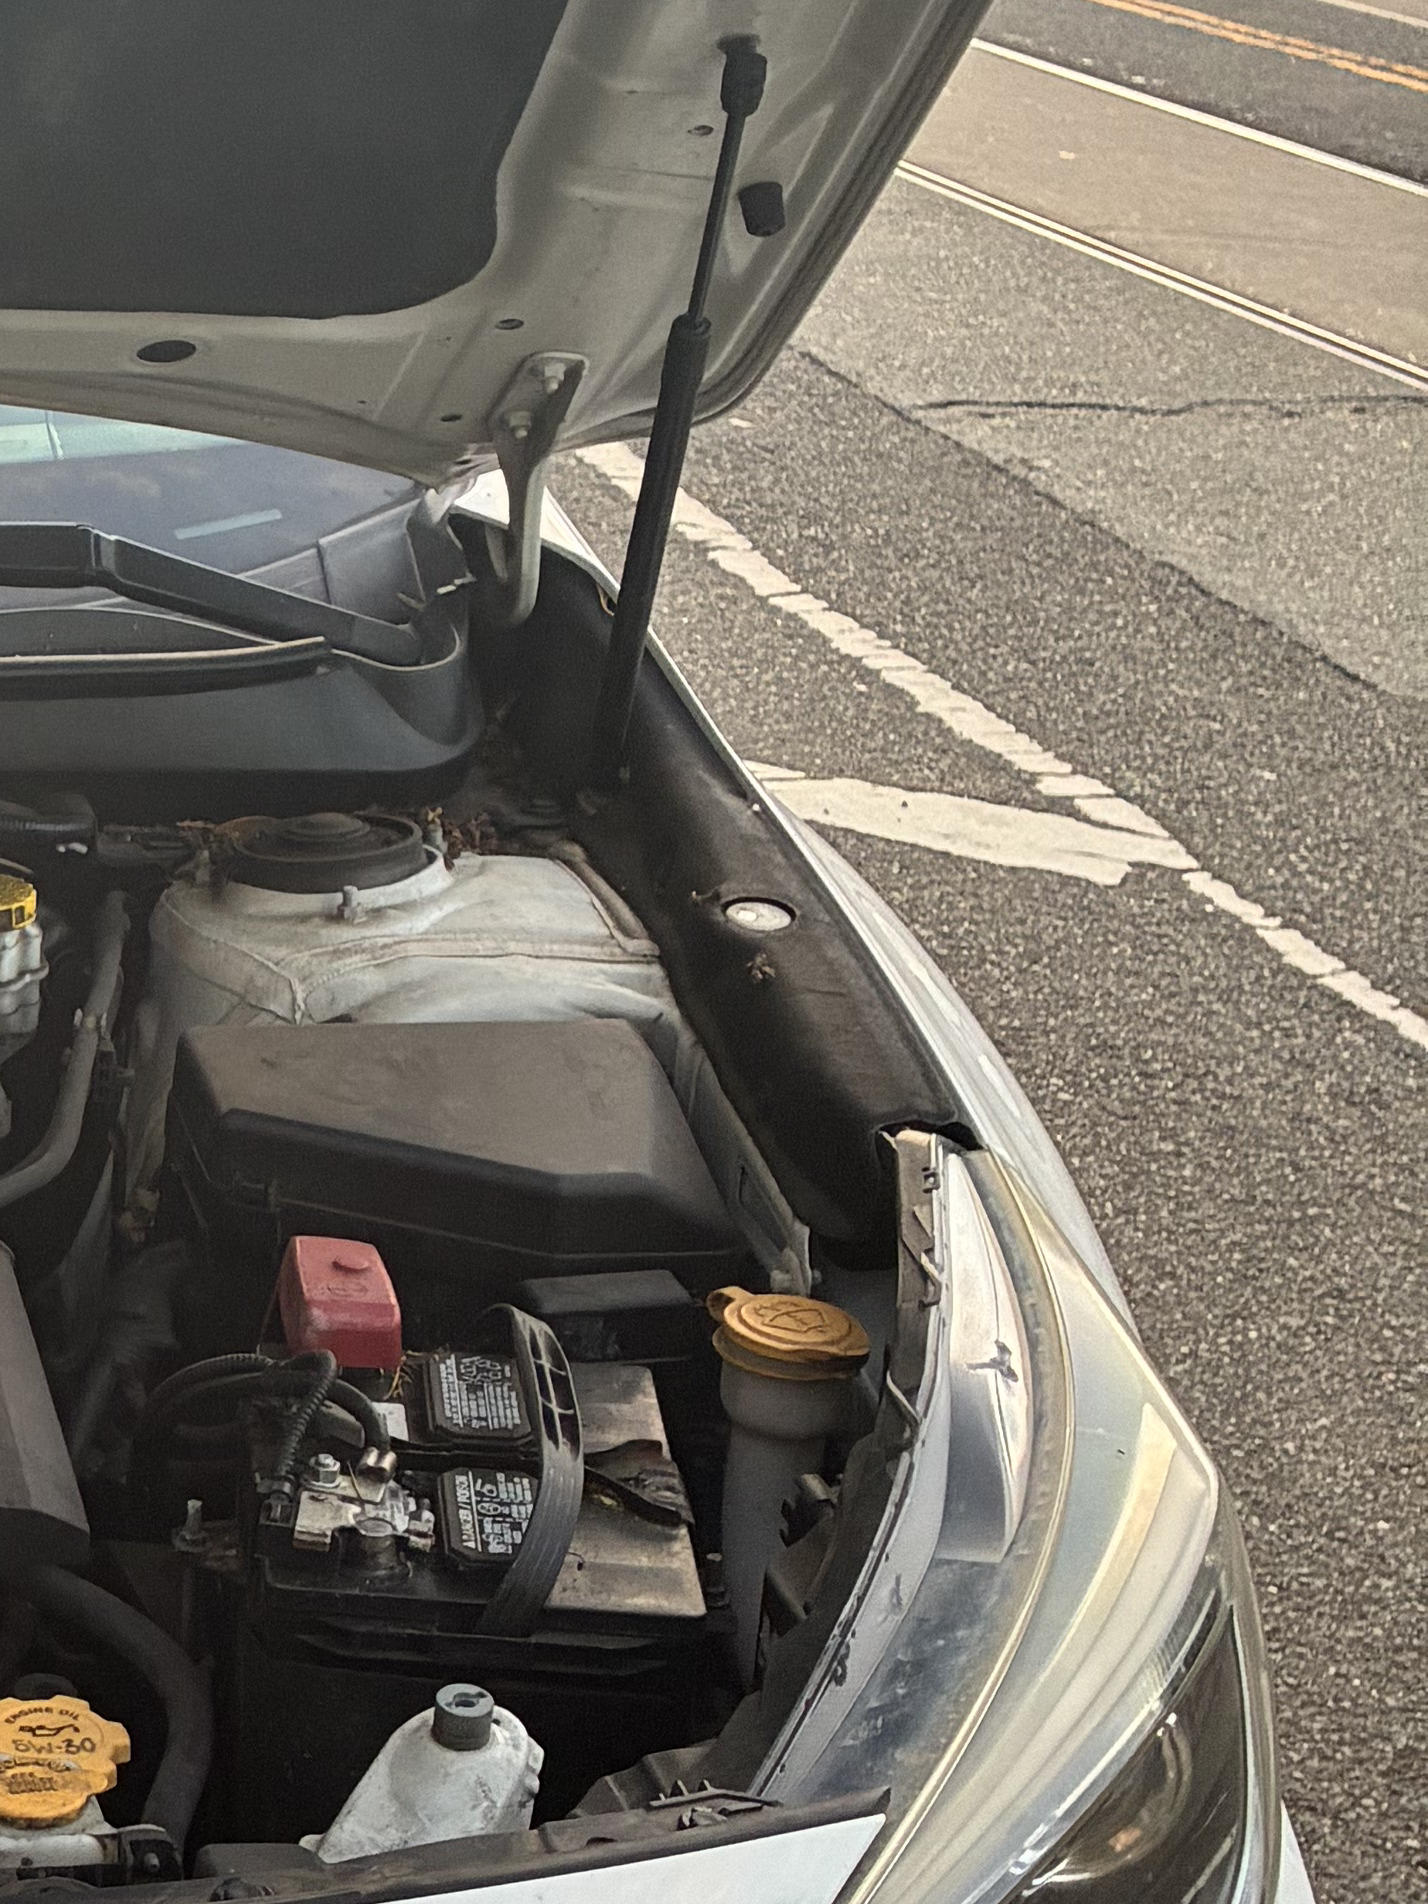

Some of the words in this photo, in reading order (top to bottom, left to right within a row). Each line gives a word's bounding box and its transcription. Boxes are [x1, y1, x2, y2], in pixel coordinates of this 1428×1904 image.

[4, 1707, 54, 1725] ENGINE
[59, 1709, 81, 1722] OIL
[11, 1737, 96, 1755] 5W-30
